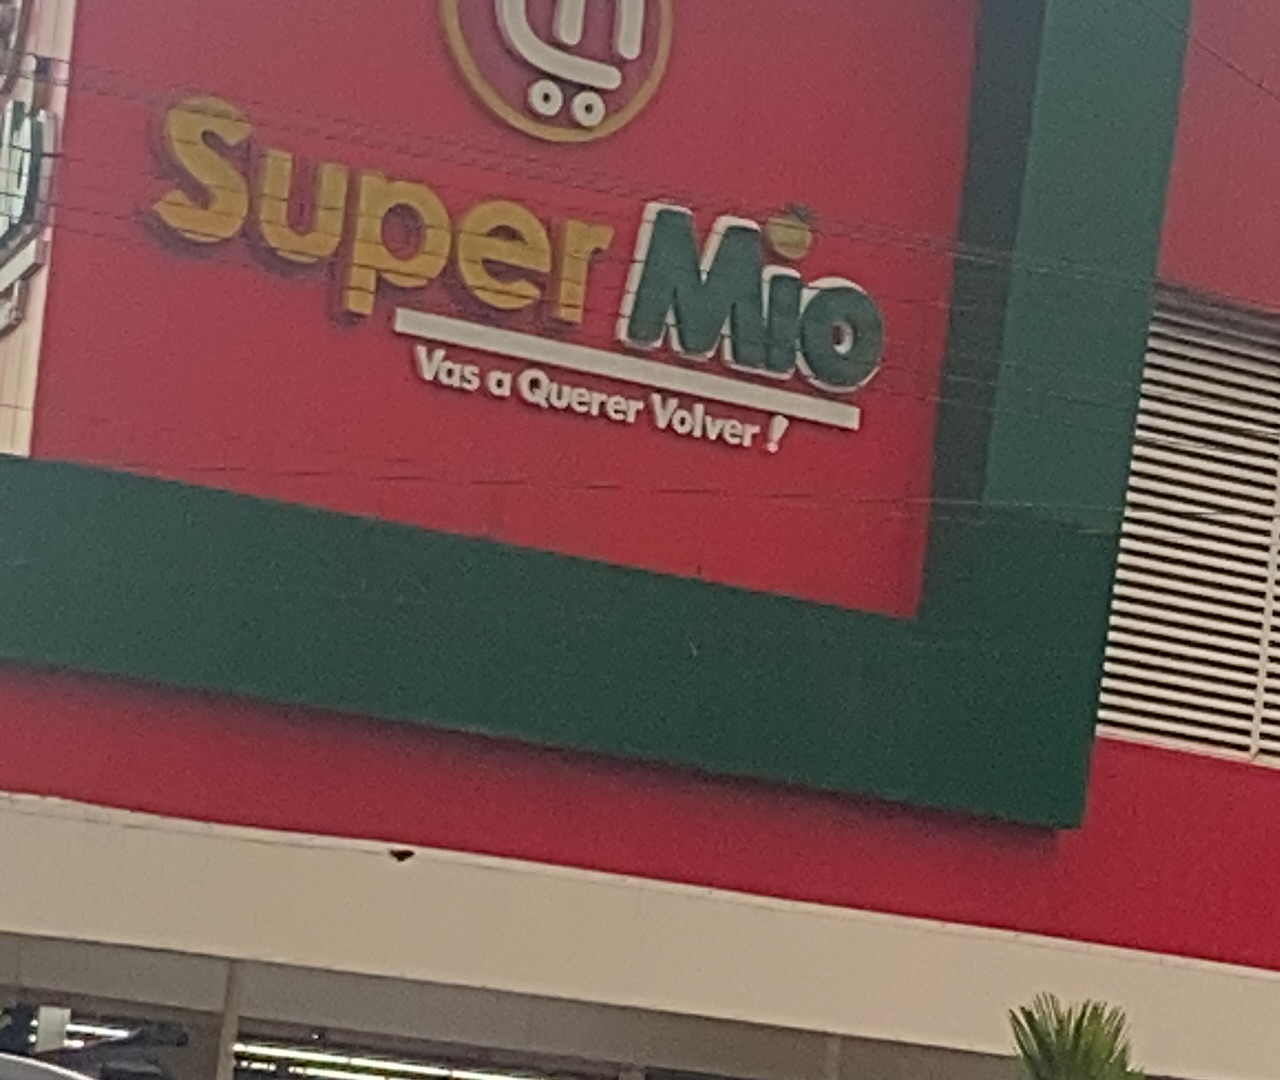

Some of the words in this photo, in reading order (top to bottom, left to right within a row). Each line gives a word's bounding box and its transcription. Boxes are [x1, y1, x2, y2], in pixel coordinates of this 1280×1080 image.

[153, 95, 615, 323] Super
[415, 344, 481, 392] Vas
[486, 370, 511, 397] a
[516, 367, 643, 424] Querer
[650, 392, 761, 448] Volver
